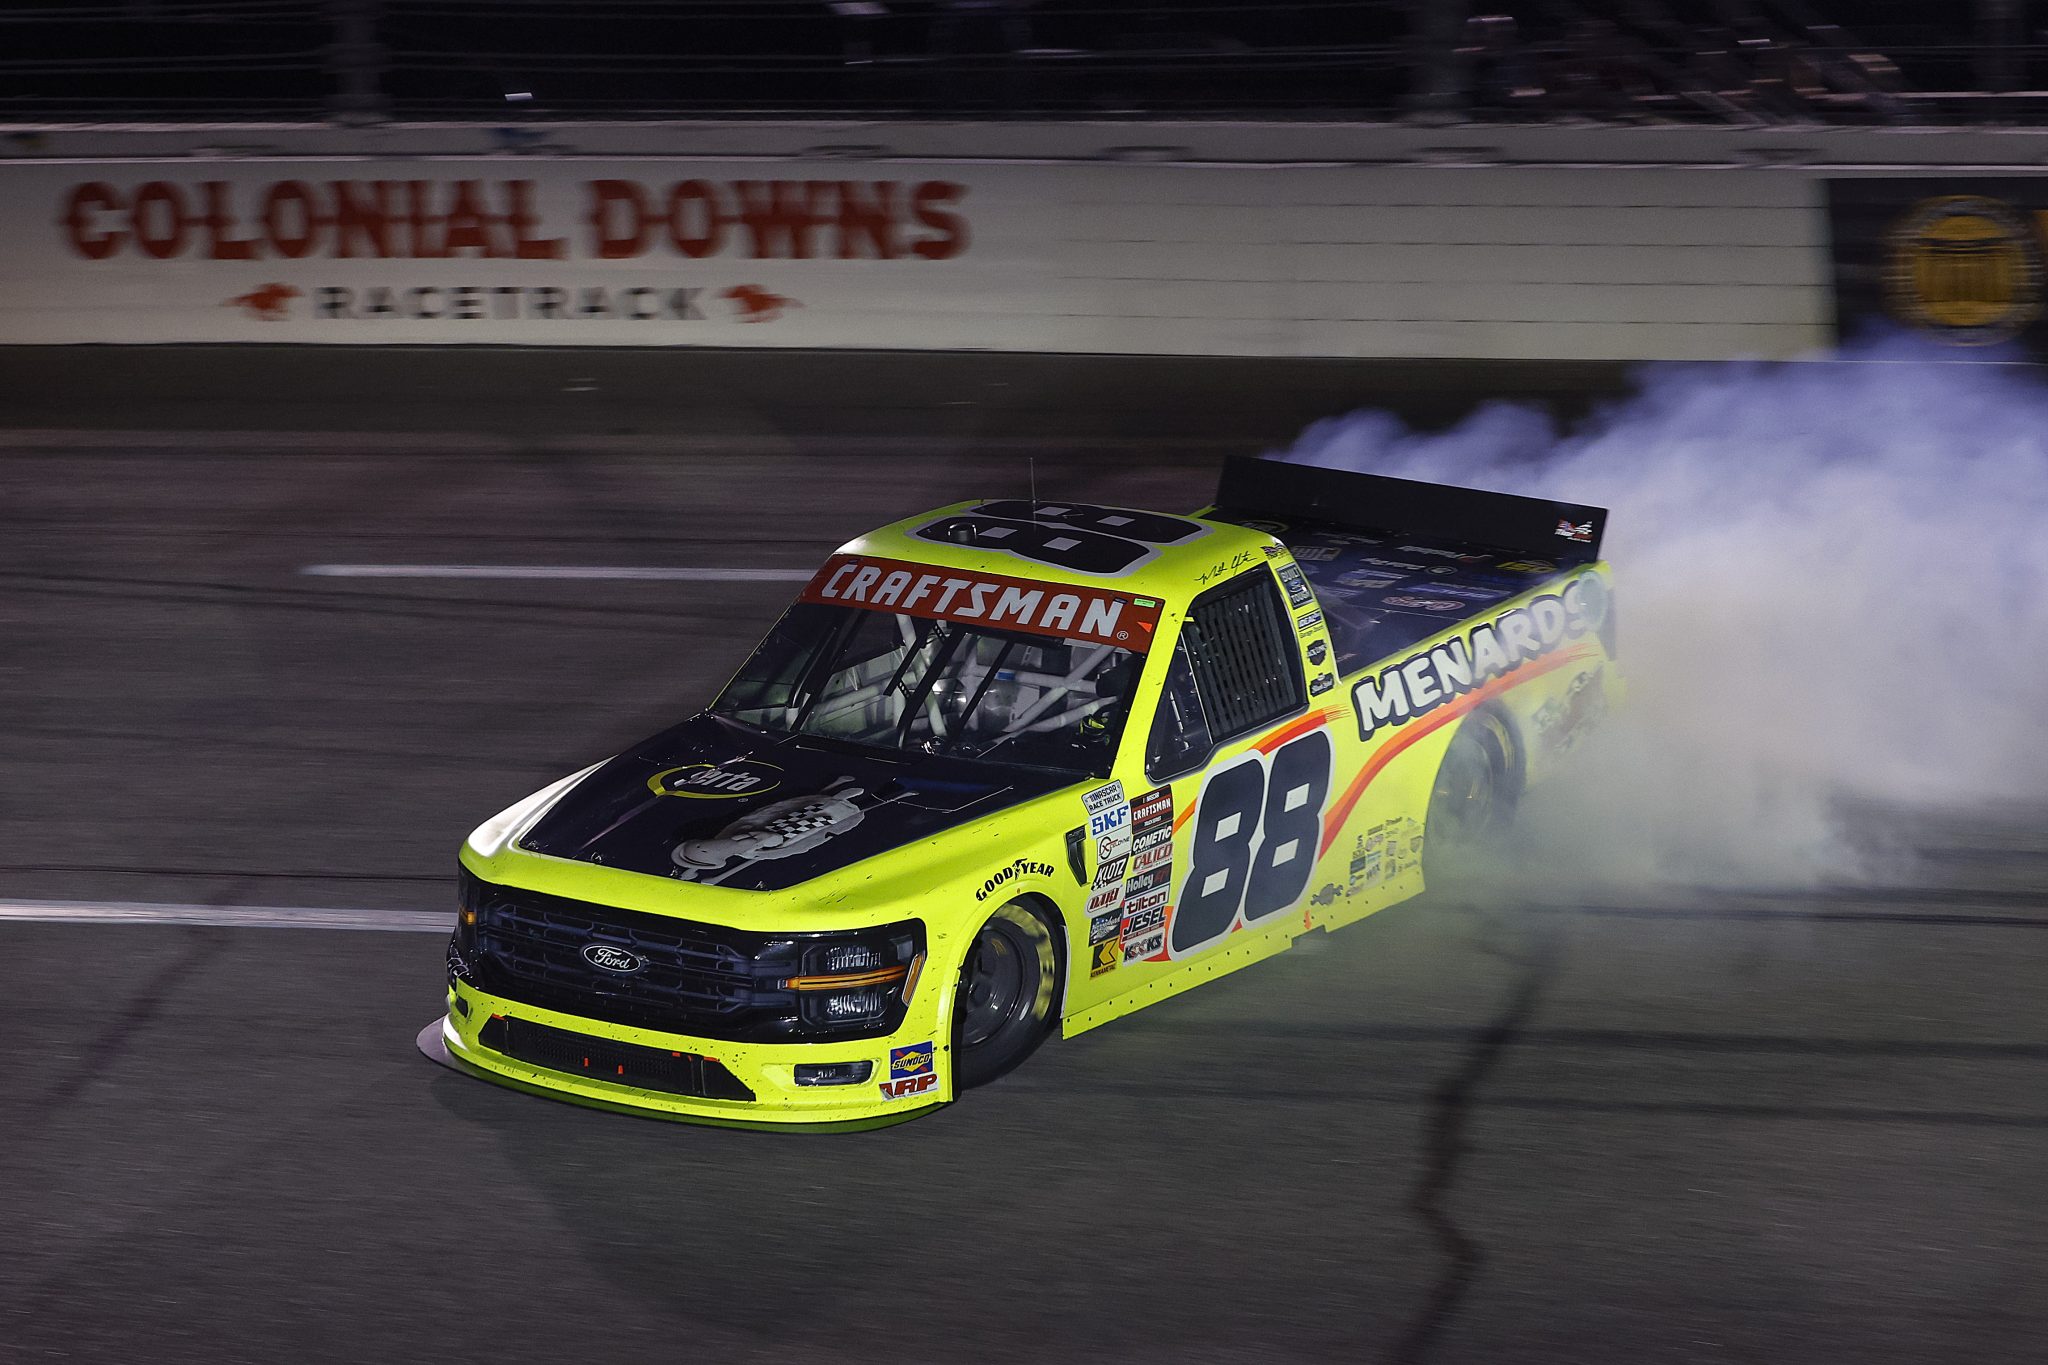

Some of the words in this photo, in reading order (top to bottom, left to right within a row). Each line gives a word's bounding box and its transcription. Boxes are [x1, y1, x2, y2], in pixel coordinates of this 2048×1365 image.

[62, 179, 566, 261] COLONIAL
[590, 178, 971, 261] DOWNS
[314, 286, 710, 321] RACETRACK
[821, 564, 1122, 638] CRAFTSMAN
[1351, 578, 1603, 741] MENARDS
[1088, 800, 1104, 811] RACE
[1104, 792, 1121, 806] TRUCK
[1133, 797, 1171, 821] CRAFTSMAN
[1091, 805, 1129, 836] SKF
[1132, 825, 1172, 851] COMETIC
[1172, 727, 1332, 953] 88
[1133, 842, 1173, 871] CALICO
[1096, 858, 1127, 883] KLOTZ
[1126, 873, 1154, 893] Holley
[1126, 891, 1166, 915] tilton
[1123, 906, 1167, 936] JESEL
[594, 948, 631, 969] Ford
[892, 1053, 932, 1070] SUNOCO
[879, 1073, 938, 1098] ARP
